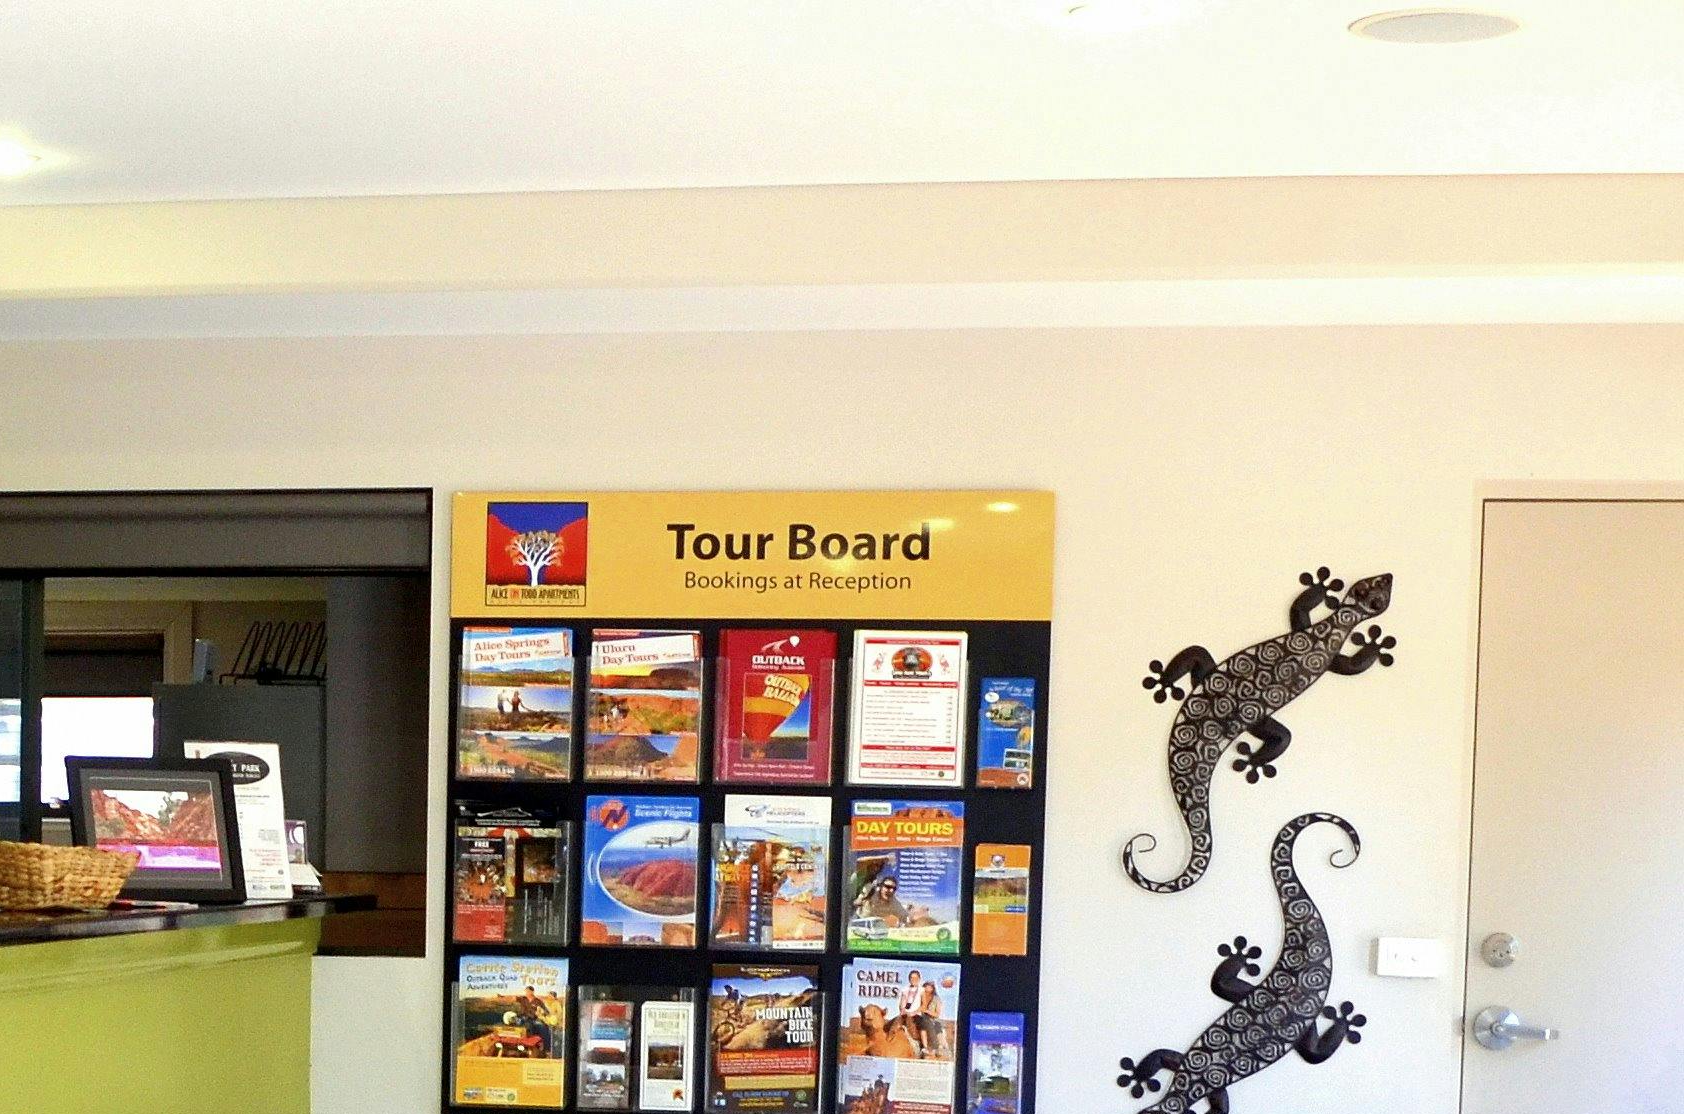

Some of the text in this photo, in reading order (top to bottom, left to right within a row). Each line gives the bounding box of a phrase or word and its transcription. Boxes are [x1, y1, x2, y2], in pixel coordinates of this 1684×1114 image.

[667, 522, 931, 561] Tour Board
[685, 571, 912, 594] Bookings at Reception
[491, 588, 508, 599] ALICE
[474, 638, 550, 651] Alice Springs
[602, 644, 636, 654] Uluru
[475, 650, 531, 662] Day Tours
[602, 653, 659, 665] Day Tours
[752, 655, 806, 666] OUTBACK
[857, 821, 954, 836] DAY TOURS
[857, 969, 903, 985] CAMEL
[858, 985, 900, 999] RIDES
[755, 1006, 814, 1020] MOUNTAIN
[788, 1018, 814, 1031] BIKE
[785, 1031, 814, 1044] TOUR
